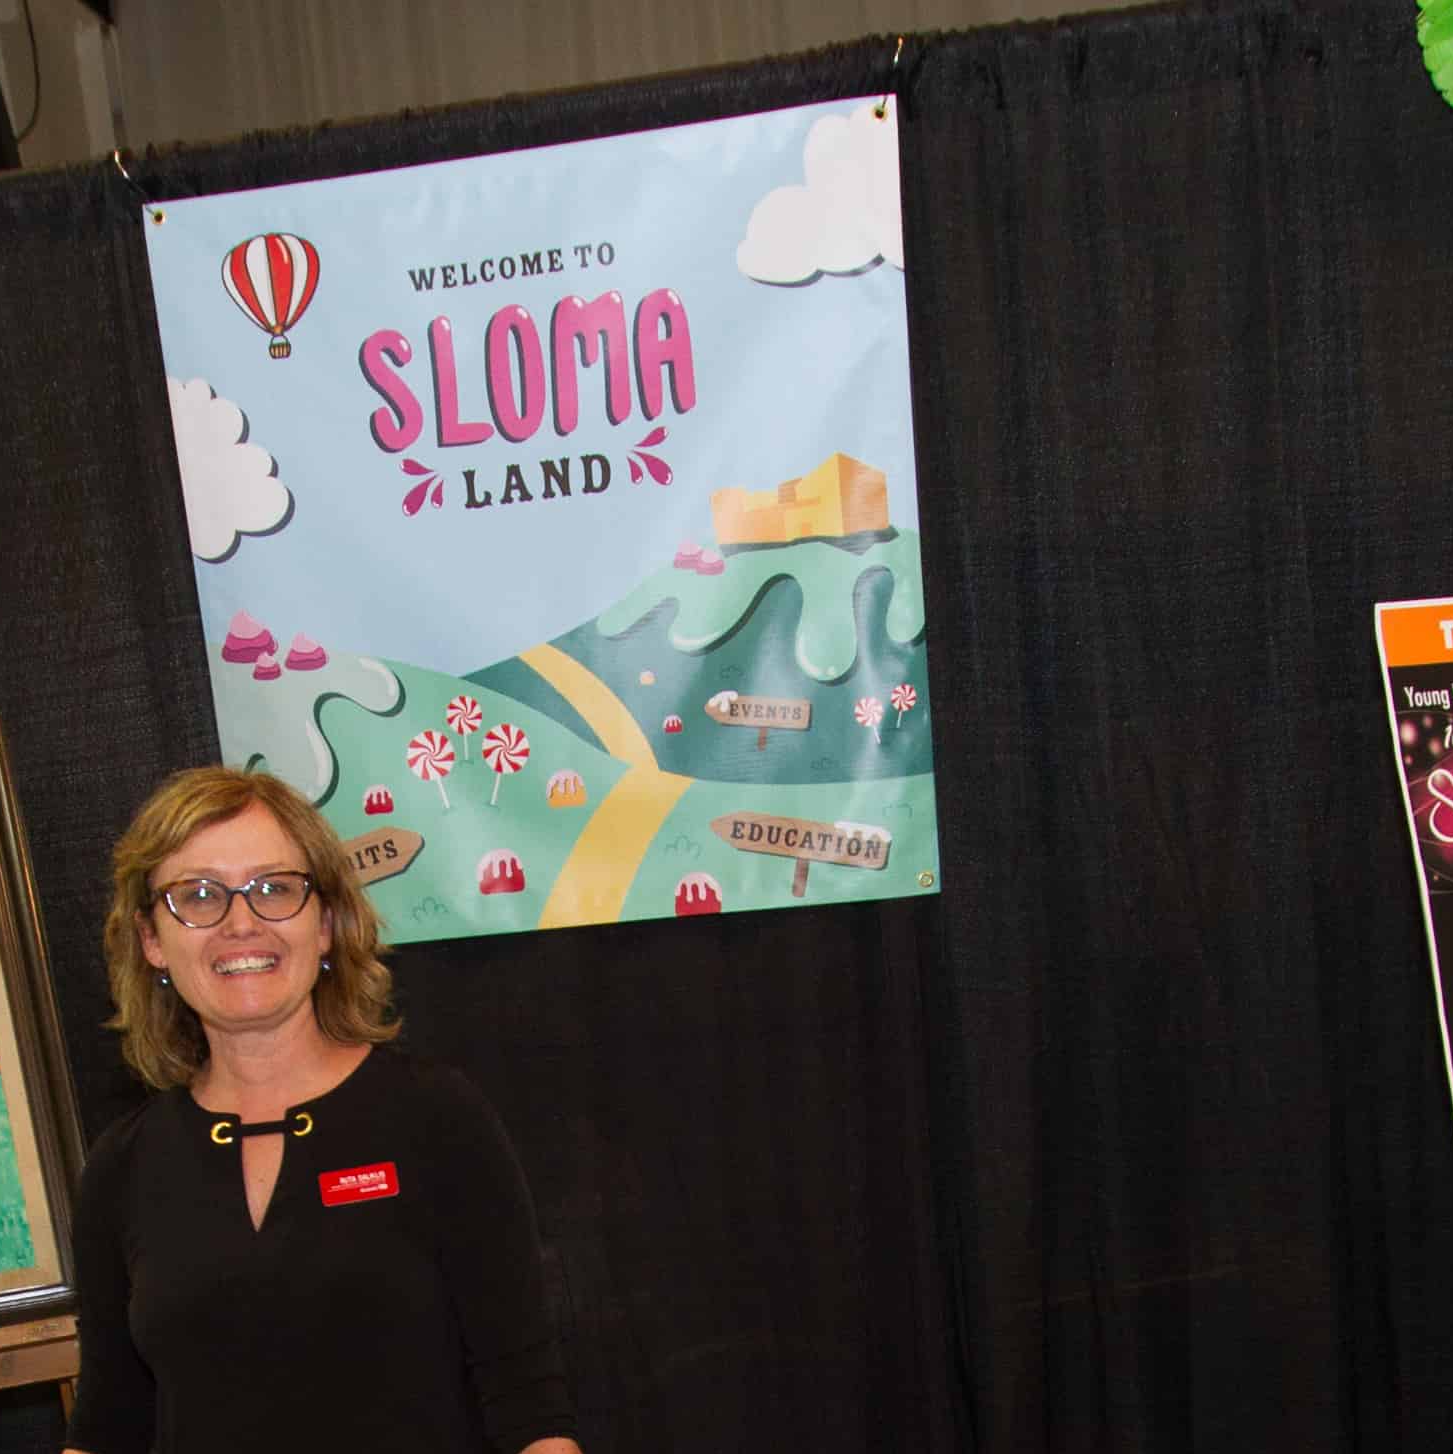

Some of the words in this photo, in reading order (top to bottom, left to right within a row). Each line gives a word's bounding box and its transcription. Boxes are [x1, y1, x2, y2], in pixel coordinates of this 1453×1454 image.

[408, 248, 565, 292] WELCOME
[574, 242, 616, 269] TO
[358, 288, 697, 454] SLOMA
[462, 454, 612, 509] LAND
[729, 703, 802, 720] EVENTS
[1404, 683, 1451, 710] Young
[348, 838, 398, 871] ITS
[731, 820, 882, 860] EDUCATION
